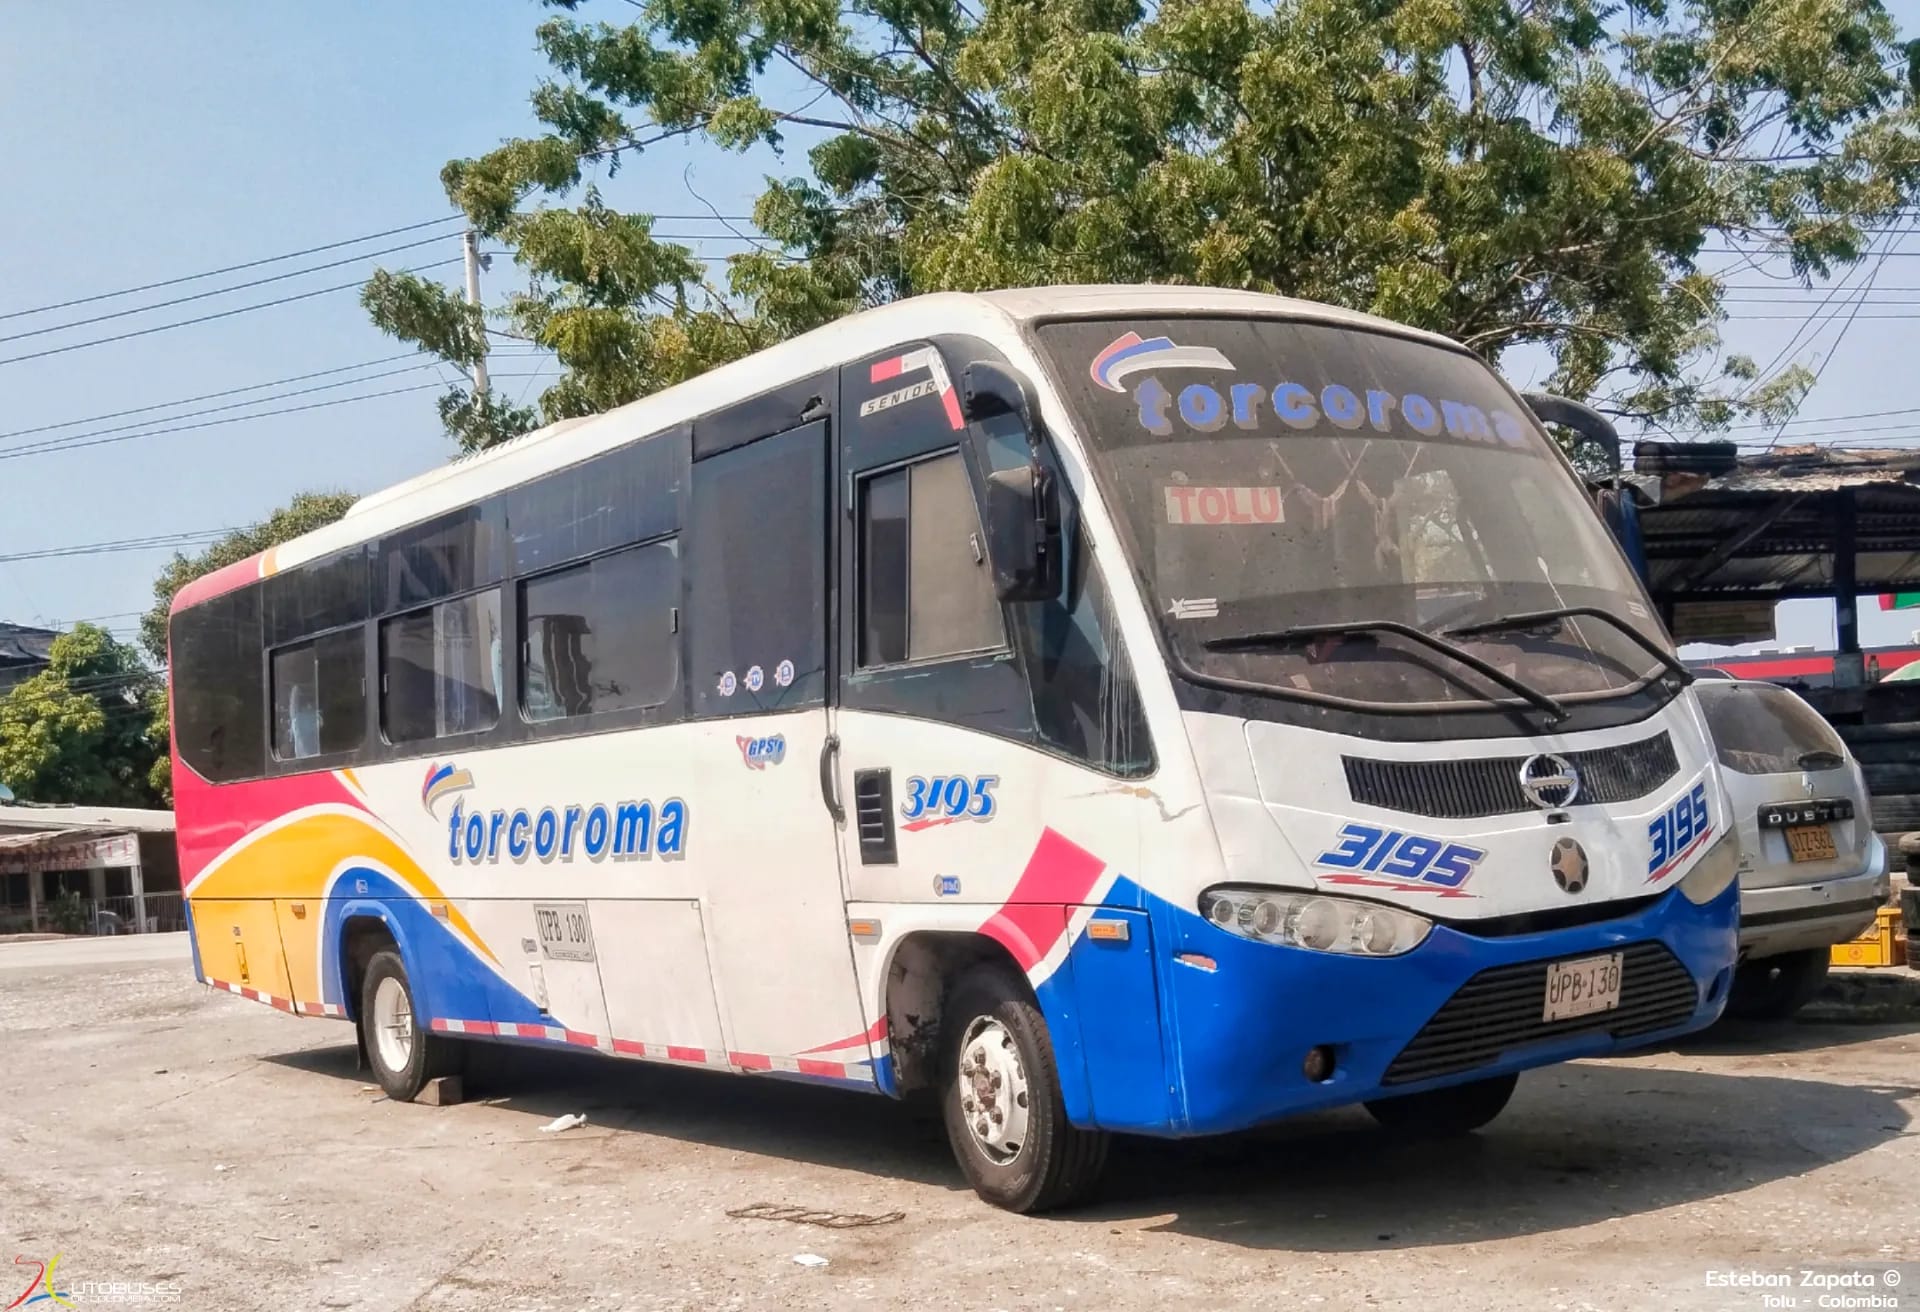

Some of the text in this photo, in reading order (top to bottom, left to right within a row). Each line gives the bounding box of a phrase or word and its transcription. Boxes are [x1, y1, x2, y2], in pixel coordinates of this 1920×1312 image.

[866, 381, 935, 413] SENIOR
[1134, 377, 1527, 447] torcoroma
[1171, 487, 1280, 523] TOLU
[901, 775, 999, 822] 3195
[449, 796, 688, 864] torcoroma
[1313, 822, 1488, 888] 3195
[1648, 782, 1710, 875] 3195
[537, 910, 586, 943] UPB 130
